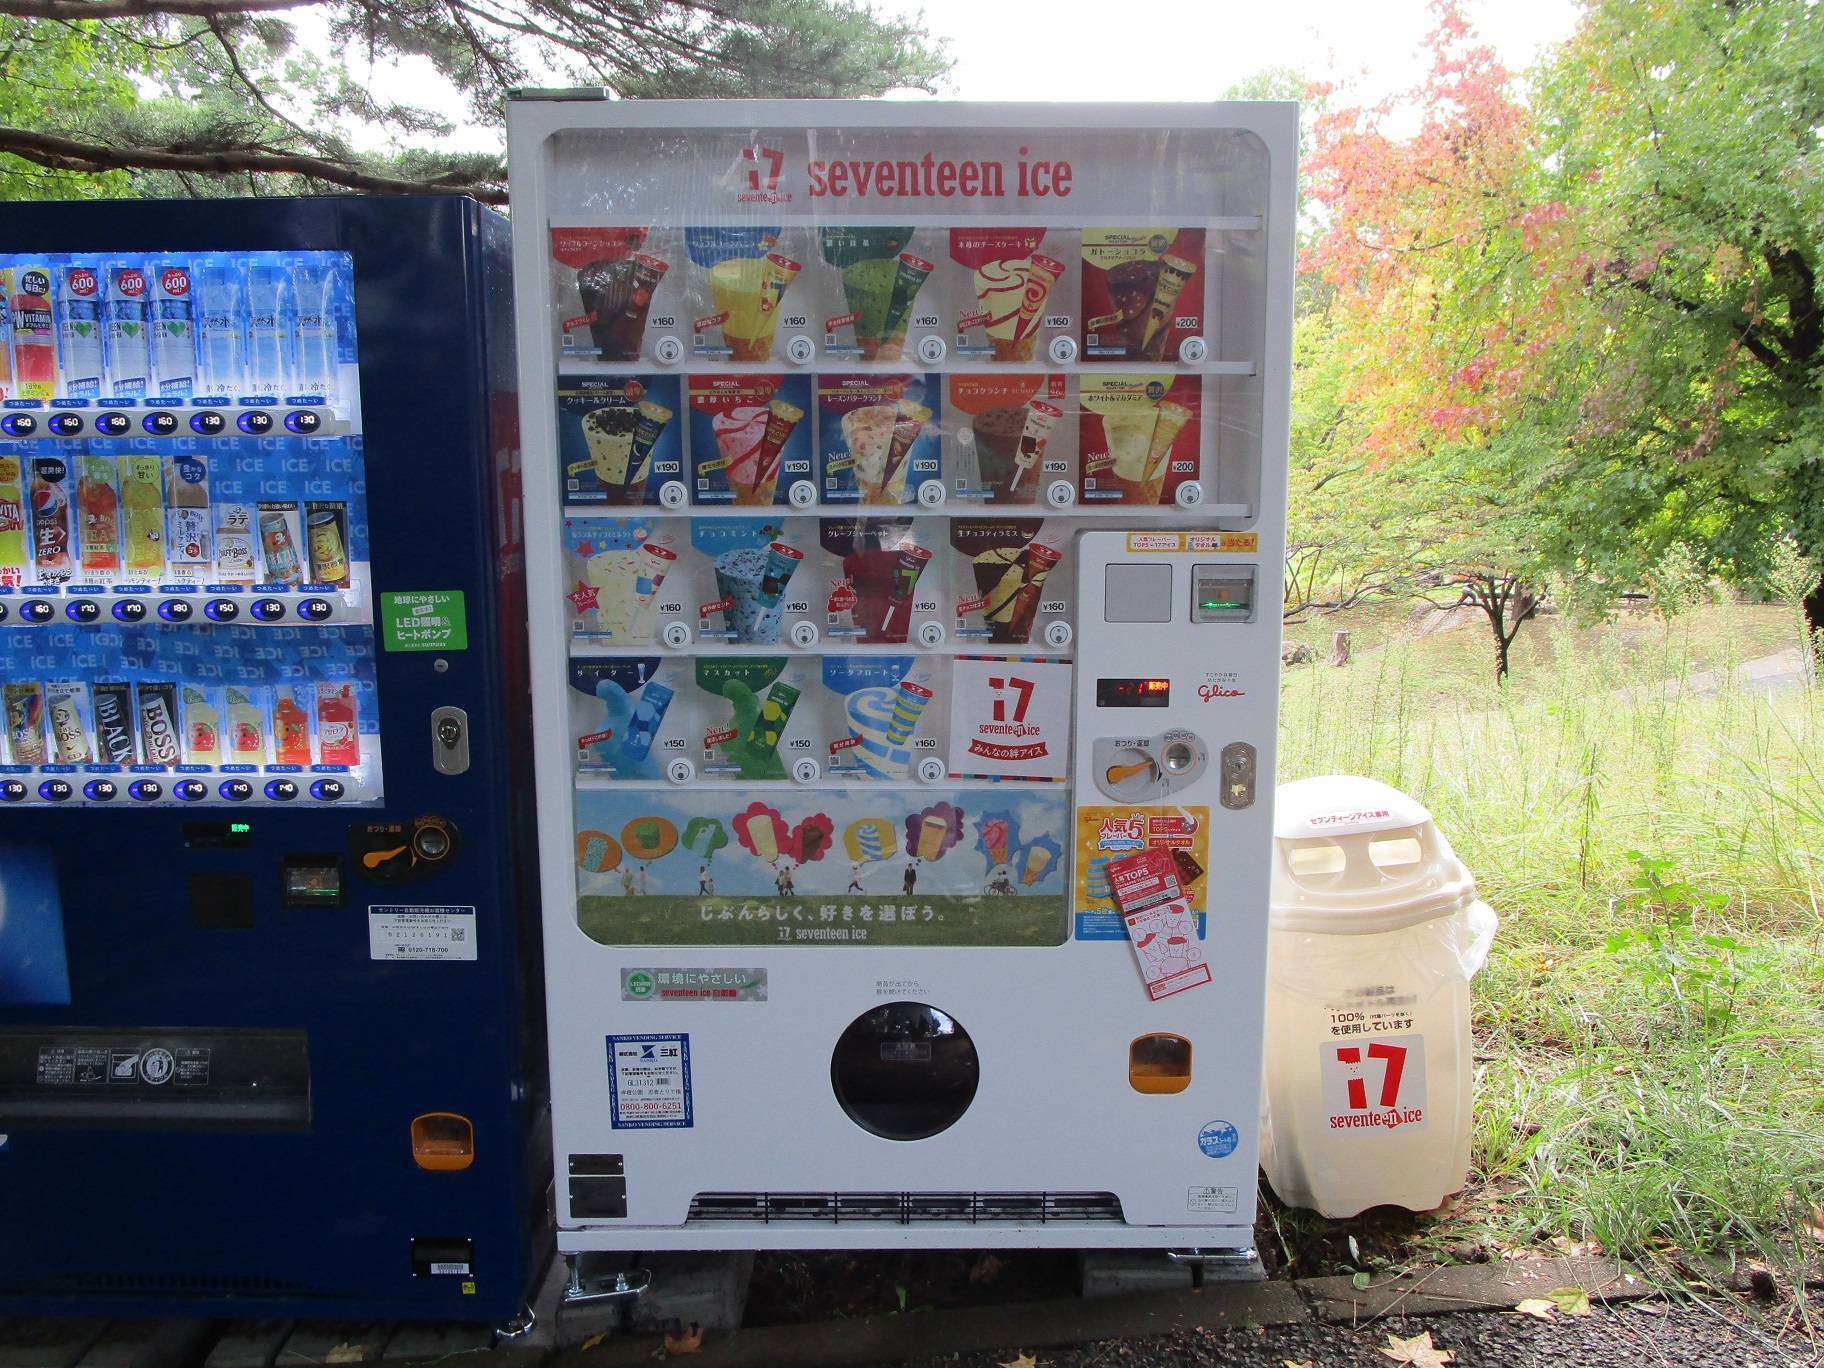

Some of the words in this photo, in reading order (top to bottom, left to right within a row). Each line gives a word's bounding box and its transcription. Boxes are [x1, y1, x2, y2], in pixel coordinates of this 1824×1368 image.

[808, 151, 1005, 197] seventeen
[1018, 146, 1073, 197] ice
[71, 277, 94, 290] 600
[120, 277, 143, 291] 600
[165, 276, 187, 290] 600
[55, 438, 82, 449] ICE
[173, 438, 197, 449] ICE
[282, 459, 309, 472] ICE
[326, 459, 353, 472] ICE
[260, 481, 288, 494] ICE
[39, 528, 56, 546] 生
[38, 546, 61, 557] ZERO
[396, 628, 452, 640] ヒートポンプ
[31, 656, 56, 669] ICE
[72, 655, 97, 668] ICE
[1197, 684, 1246, 703] Glico
[99, 696, 133, 763] BLACK
[146, 703, 178, 764] BOSS
[1026, 723, 1040, 736] ice
[973, 743, 1044, 759] みんなの絆アイス
[1309, 809, 1390, 825] セブンティーンアイス専用
[1099, 818, 1129, 833] 人気
[700, 904, 945, 921] じぶんらしく、好きを選ぼう。
[795, 927, 850, 940] seventeen
[851, 925, 867, 940] ice
[657, 972, 746, 985] 環境にやさしい
[1330, 1011, 1365, 1023] 100%
[1330, 1018, 1415, 1036] を使用しています
[1403, 1106, 1423, 1123] ice
